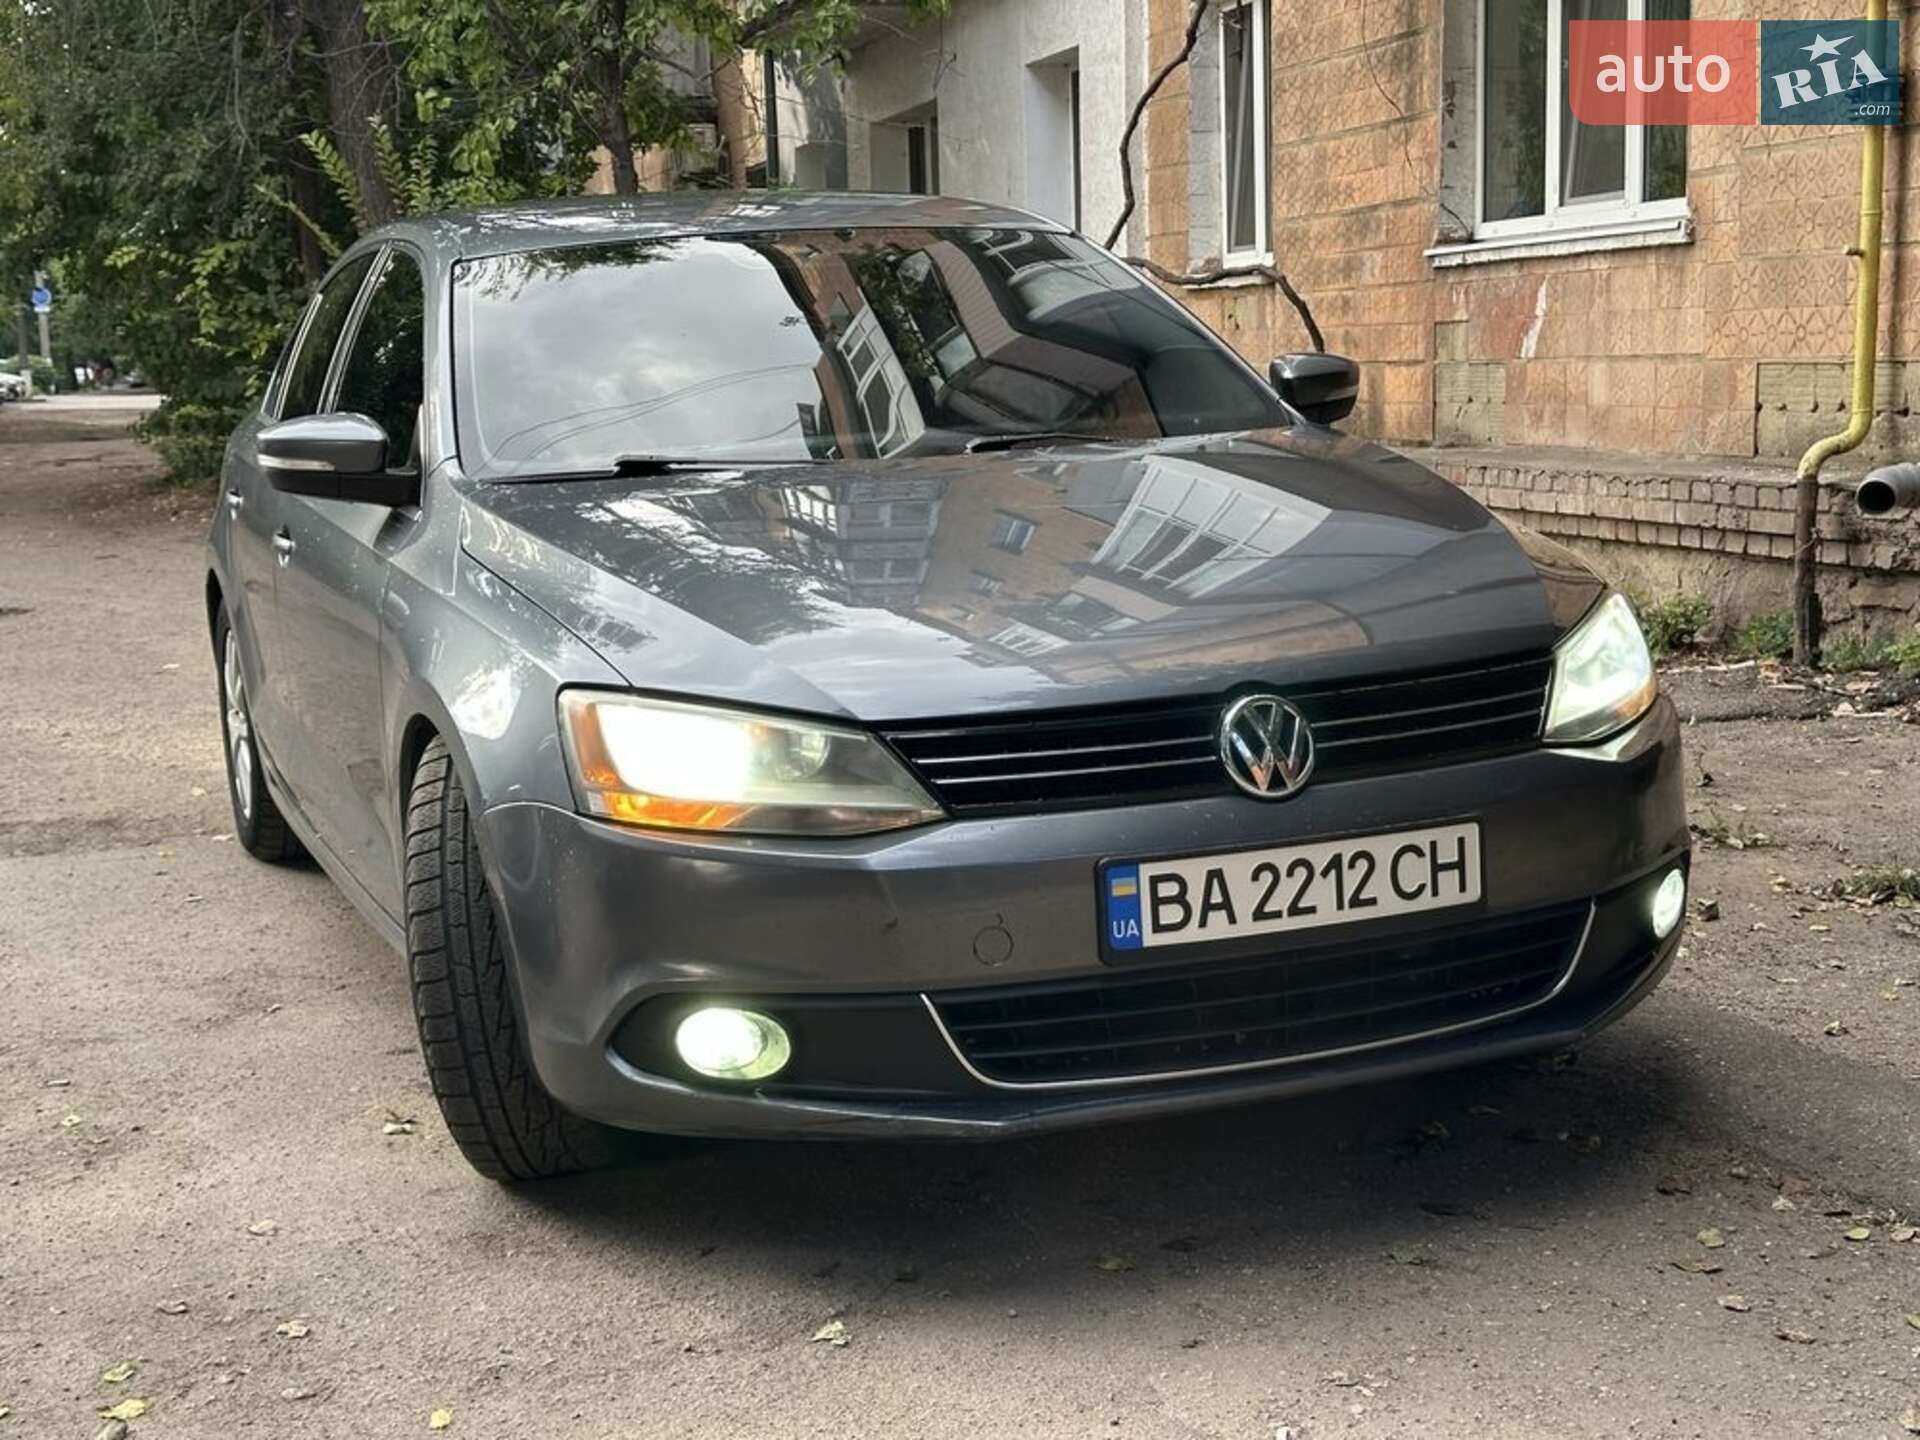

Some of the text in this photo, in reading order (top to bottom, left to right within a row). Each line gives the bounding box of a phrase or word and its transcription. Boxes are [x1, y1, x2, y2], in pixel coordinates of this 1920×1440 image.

[1148, 836, 1468, 935] BA 2212 CH
[1112, 920, 1140, 939] UA
